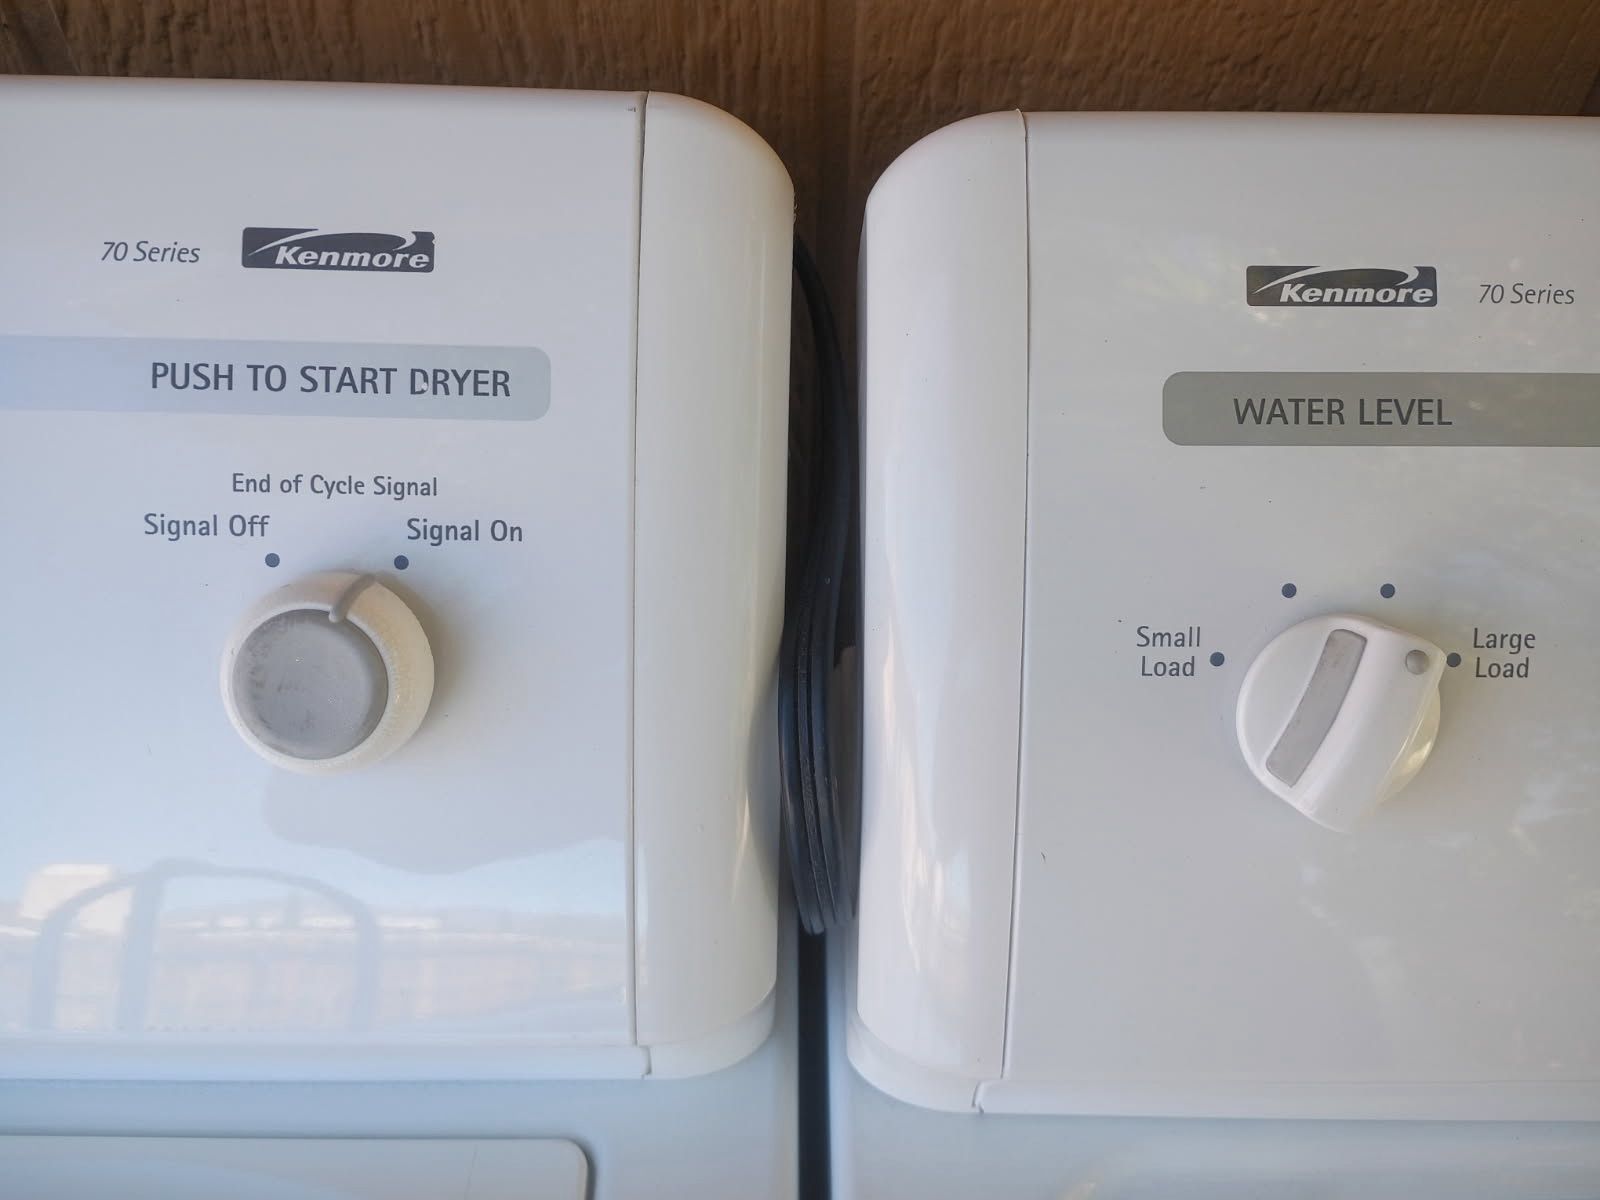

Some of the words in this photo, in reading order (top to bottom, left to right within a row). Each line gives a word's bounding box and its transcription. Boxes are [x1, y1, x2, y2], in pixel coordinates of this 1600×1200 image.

[101, 241, 128, 262] 70
[132, 240, 201, 264] Series
[274, 245, 431, 270] Kenmore
[1278, 282, 1434, 305] Kenmore
[1479, 284, 1505, 304] 70
[1510, 282, 1575, 305] Series
[151, 362, 234, 391] PUSH
[246, 364, 286, 393] TO
[300, 366, 398, 395] START
[410, 368, 511, 397] DRYER
[1233, 397, 1345, 426] WATER
[1359, 398, 1453, 426] LEVEL
[232, 472, 271, 493] End
[279, 473, 303, 494] of
[310, 474, 365, 500] Cycle
[373, 475, 438, 501] Signal
[144, 512, 218, 540] Signal
[229, 514, 271, 537] Off
[407, 517, 479, 546] Signal
[490, 519, 523, 542] On
[1136, 625, 1201, 648] Small
[1473, 627, 1536, 655] Large
[1141, 655, 1195, 677] Load
[1475, 656, 1530, 679] Load
